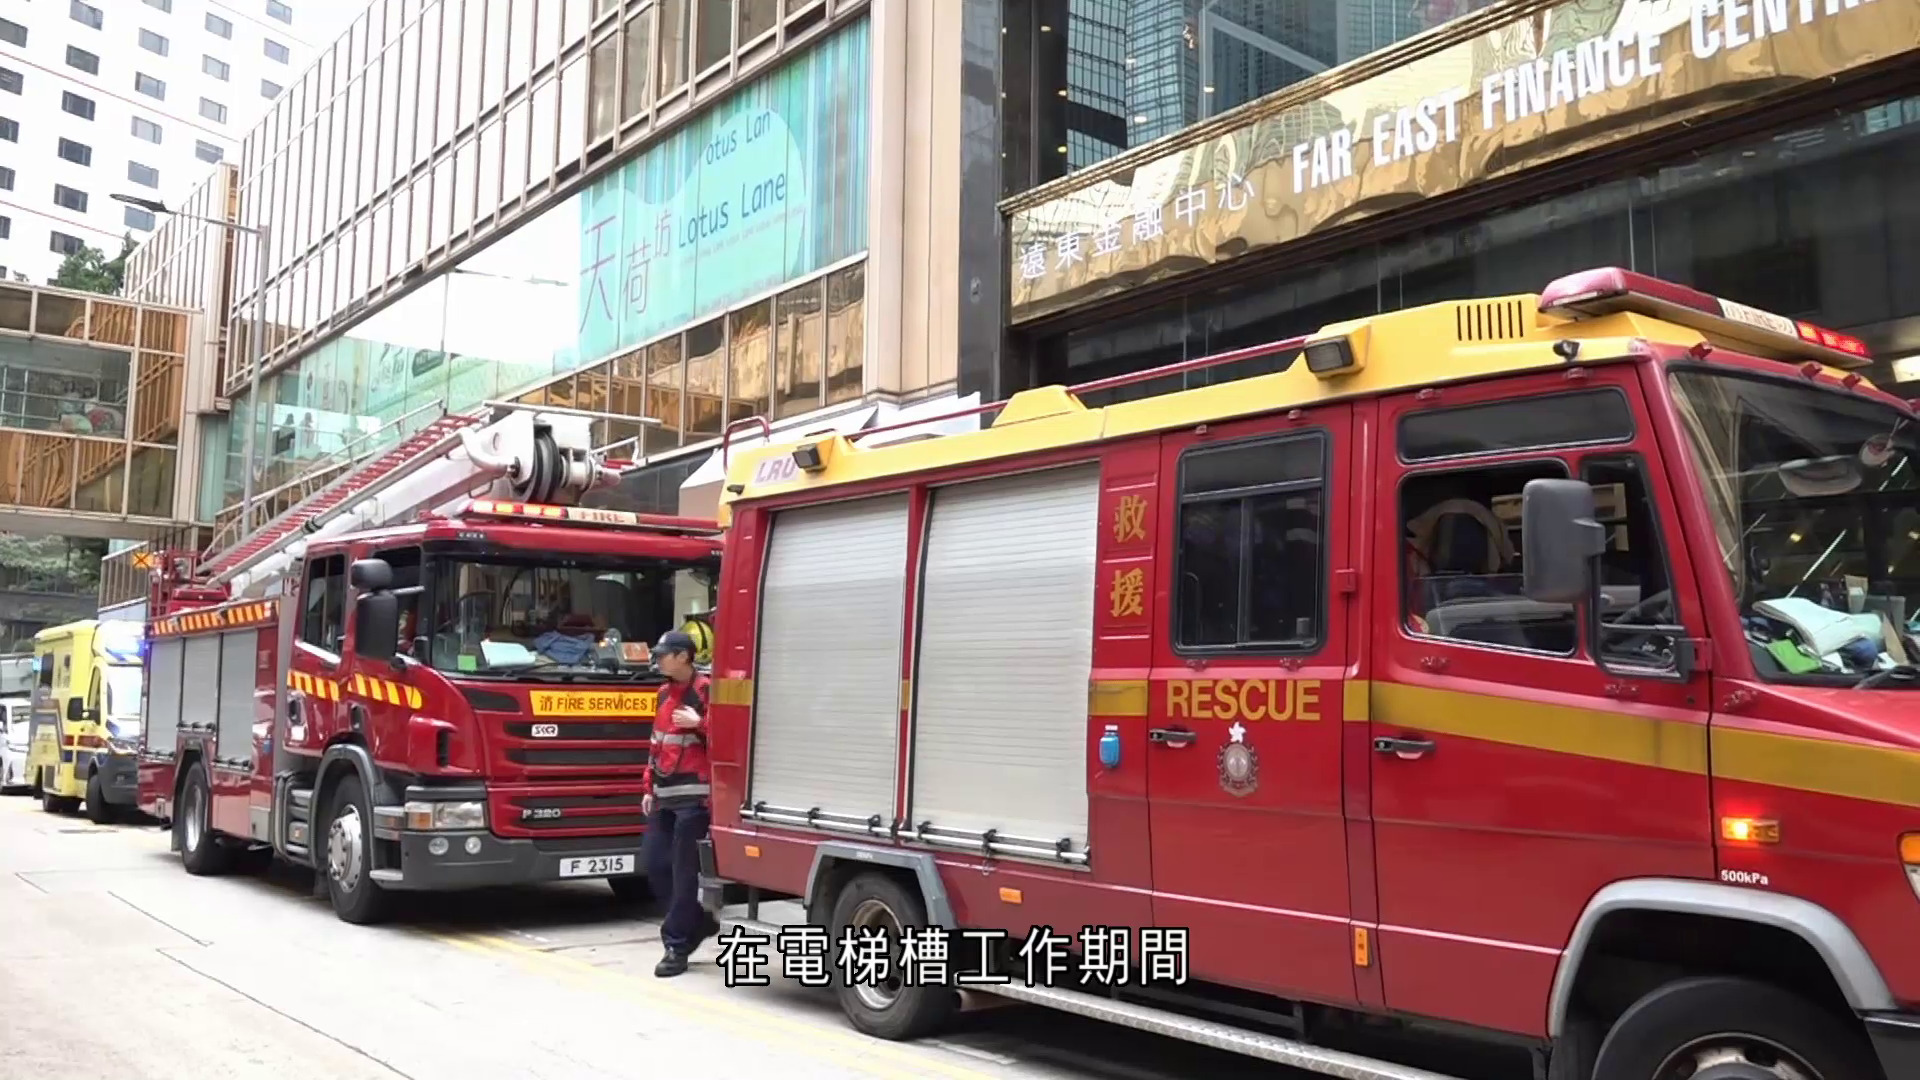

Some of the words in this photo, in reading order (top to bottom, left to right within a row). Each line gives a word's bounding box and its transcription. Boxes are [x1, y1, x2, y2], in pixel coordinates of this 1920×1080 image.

[1293, 129, 1352, 194] FAR
[1373, 86, 1466, 166] EAST
[1481, 30, 1663, 129] FINANCE
[1690, 0, 1876, 58] CEN
[679, 201, 728, 248] Lotus
[741, 173, 785, 218] Lane
[1018, 175, 1255, 281] 遠東金融中心
[755, 457, 795, 483] LRU
[1110, 494, 1148, 617] 救援
[557, 698, 584, 711] FIRE
[588, 698, 647, 711] SERVICES
[1166, 679, 1321, 720] RESCUE
[571, 860, 581, 873] F
[588, 857, 624, 873] 2315
[1721, 869, 1769, 885] 500kPa
